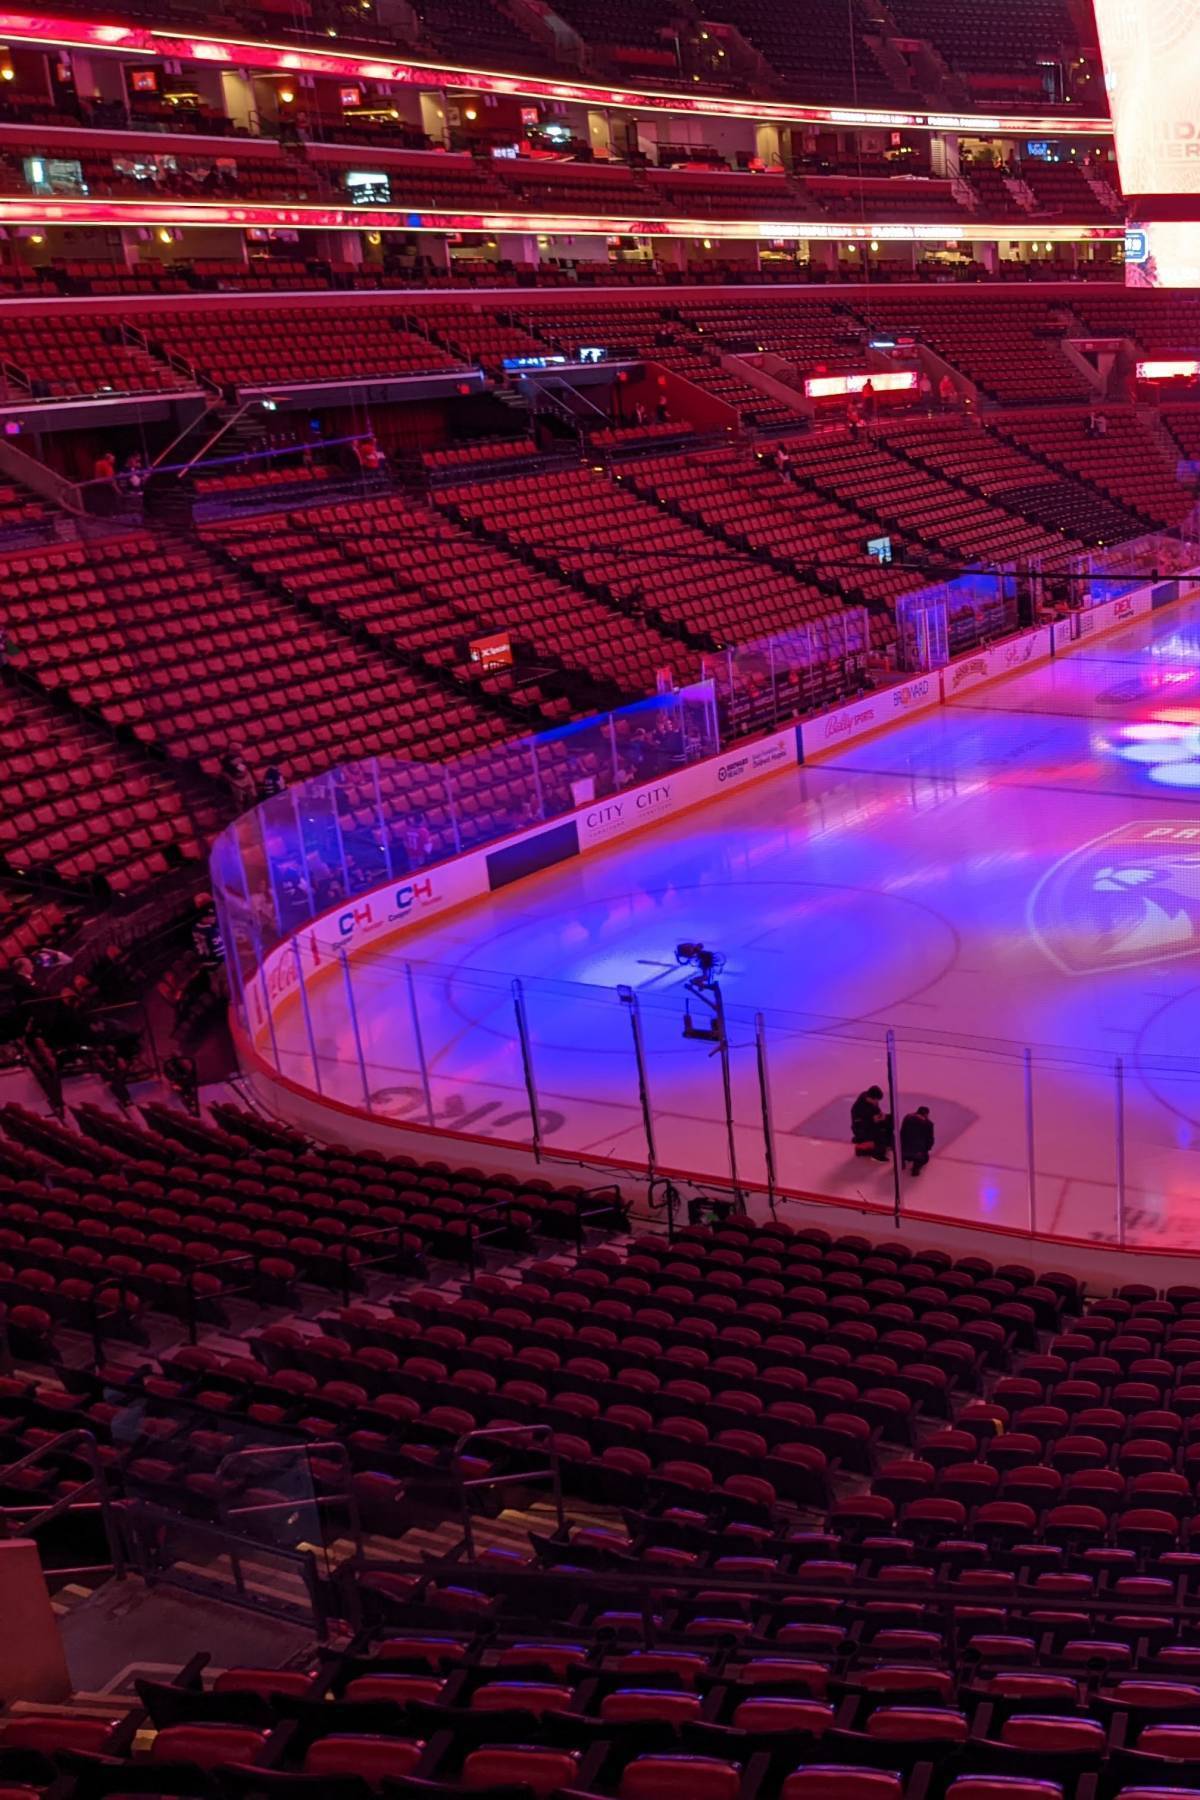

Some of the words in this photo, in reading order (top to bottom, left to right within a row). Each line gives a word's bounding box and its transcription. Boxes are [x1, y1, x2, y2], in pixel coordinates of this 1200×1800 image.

[636, 785, 671, 809] CITY
[586, 803, 623, 828] CITY
[396, 878, 432, 909] CH
[339, 903, 373, 936] CH
